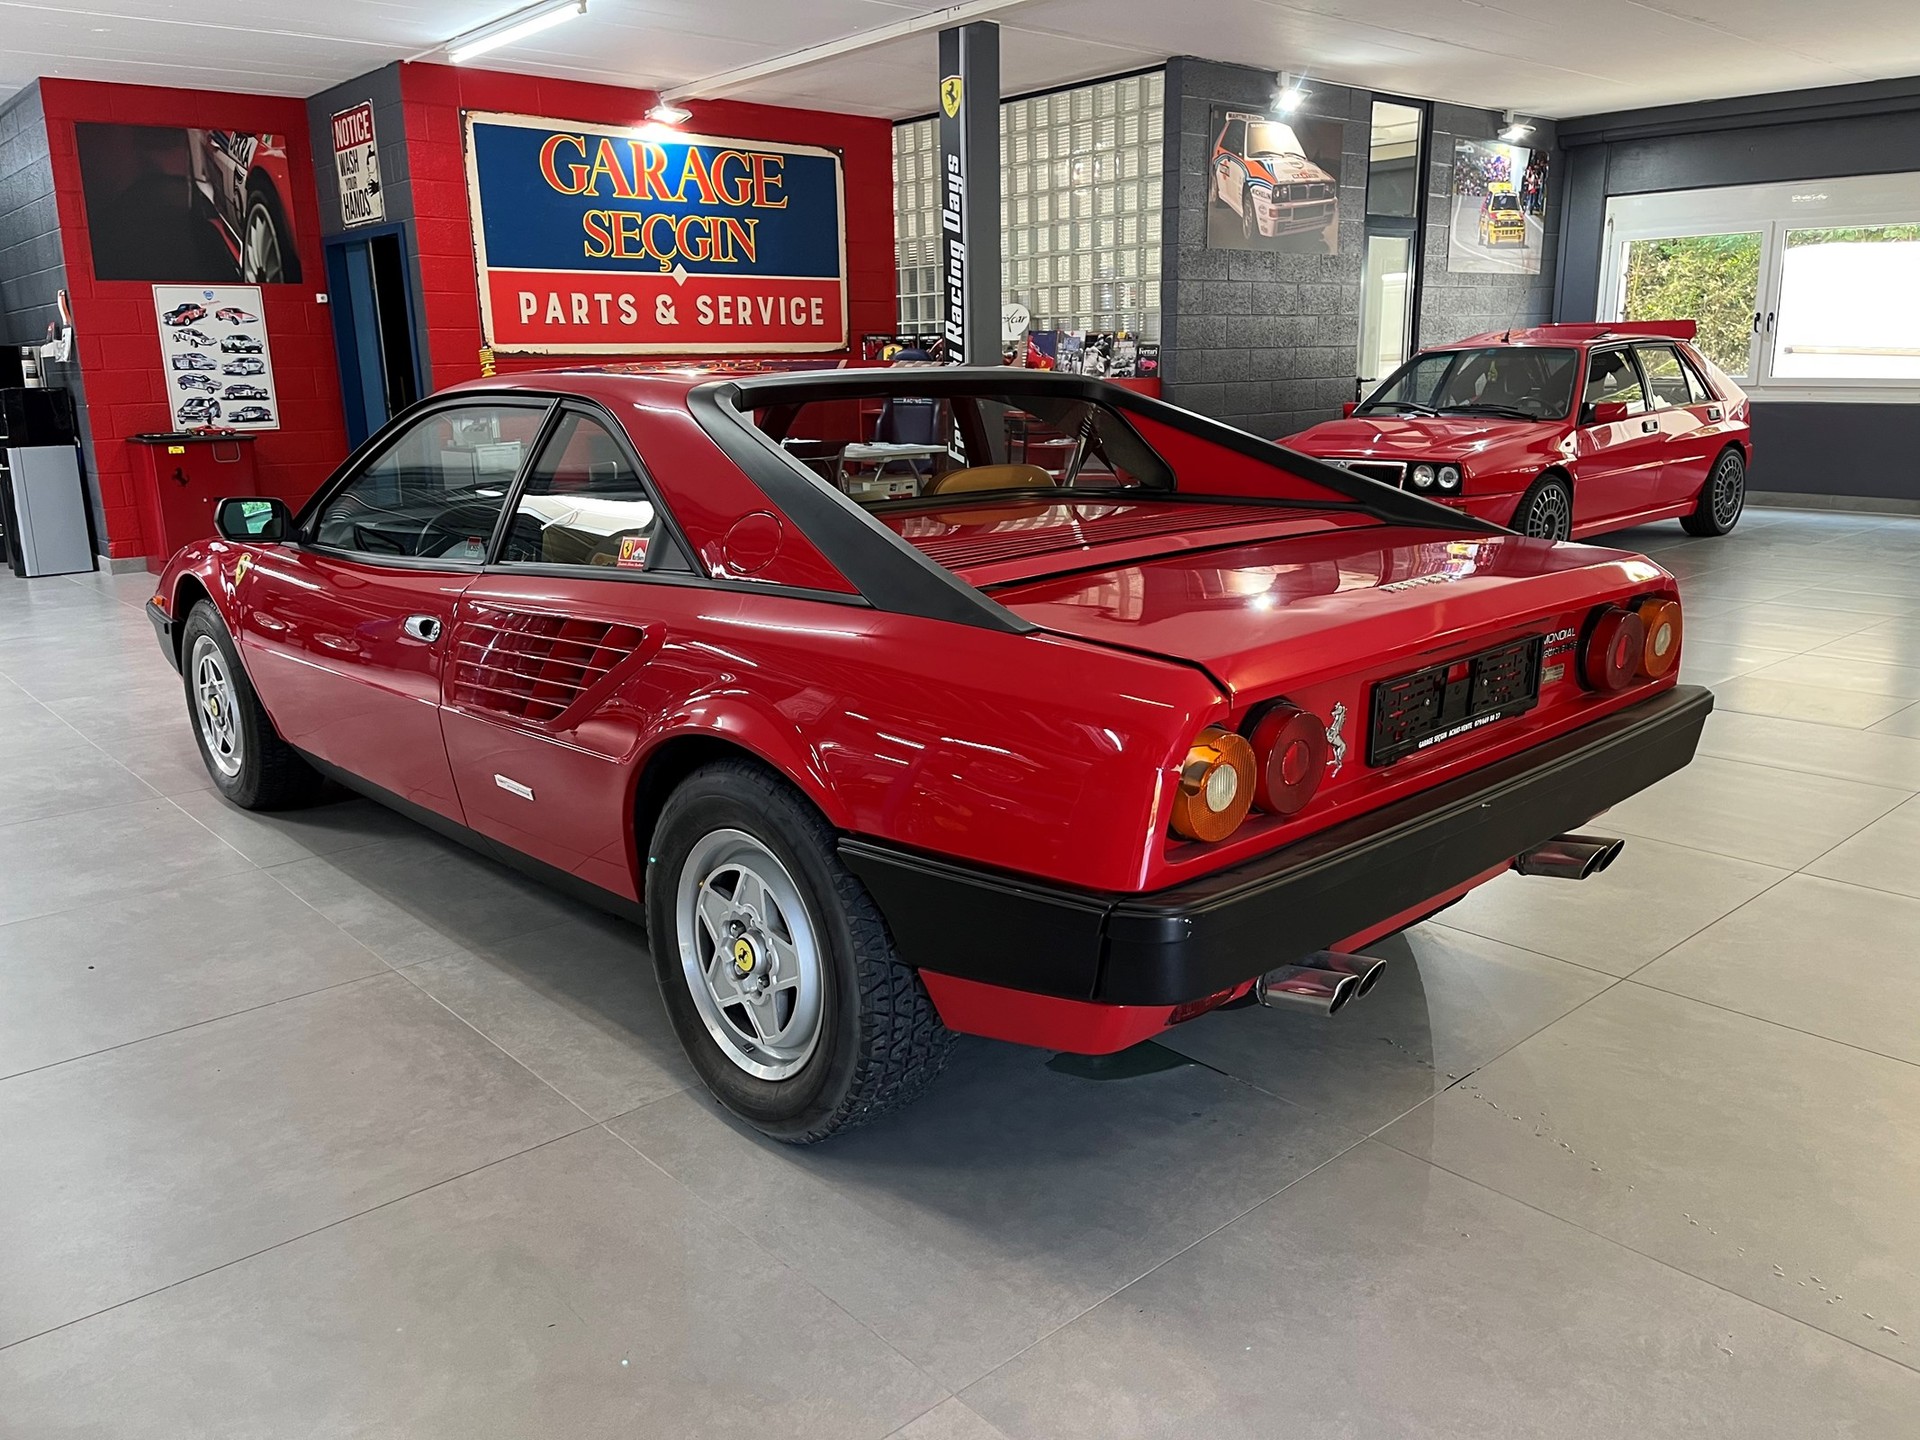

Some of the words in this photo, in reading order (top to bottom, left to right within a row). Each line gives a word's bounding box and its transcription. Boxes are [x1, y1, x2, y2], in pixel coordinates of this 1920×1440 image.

[334, 110, 371, 149] NOTICE
[338, 148, 360, 177] WASH
[539, 133, 788, 209] GARAGE
[345, 176, 358, 191] YOUR
[943, 154, 963, 234] Days
[343, 187, 372, 221] HANDS
[583, 209, 759, 272] SEÇGIN
[518, 291, 638, 325] PARTS
[655, 294, 680, 325] &
[697, 294, 825, 326] SERVICE
[945, 239, 965, 346] Racing
